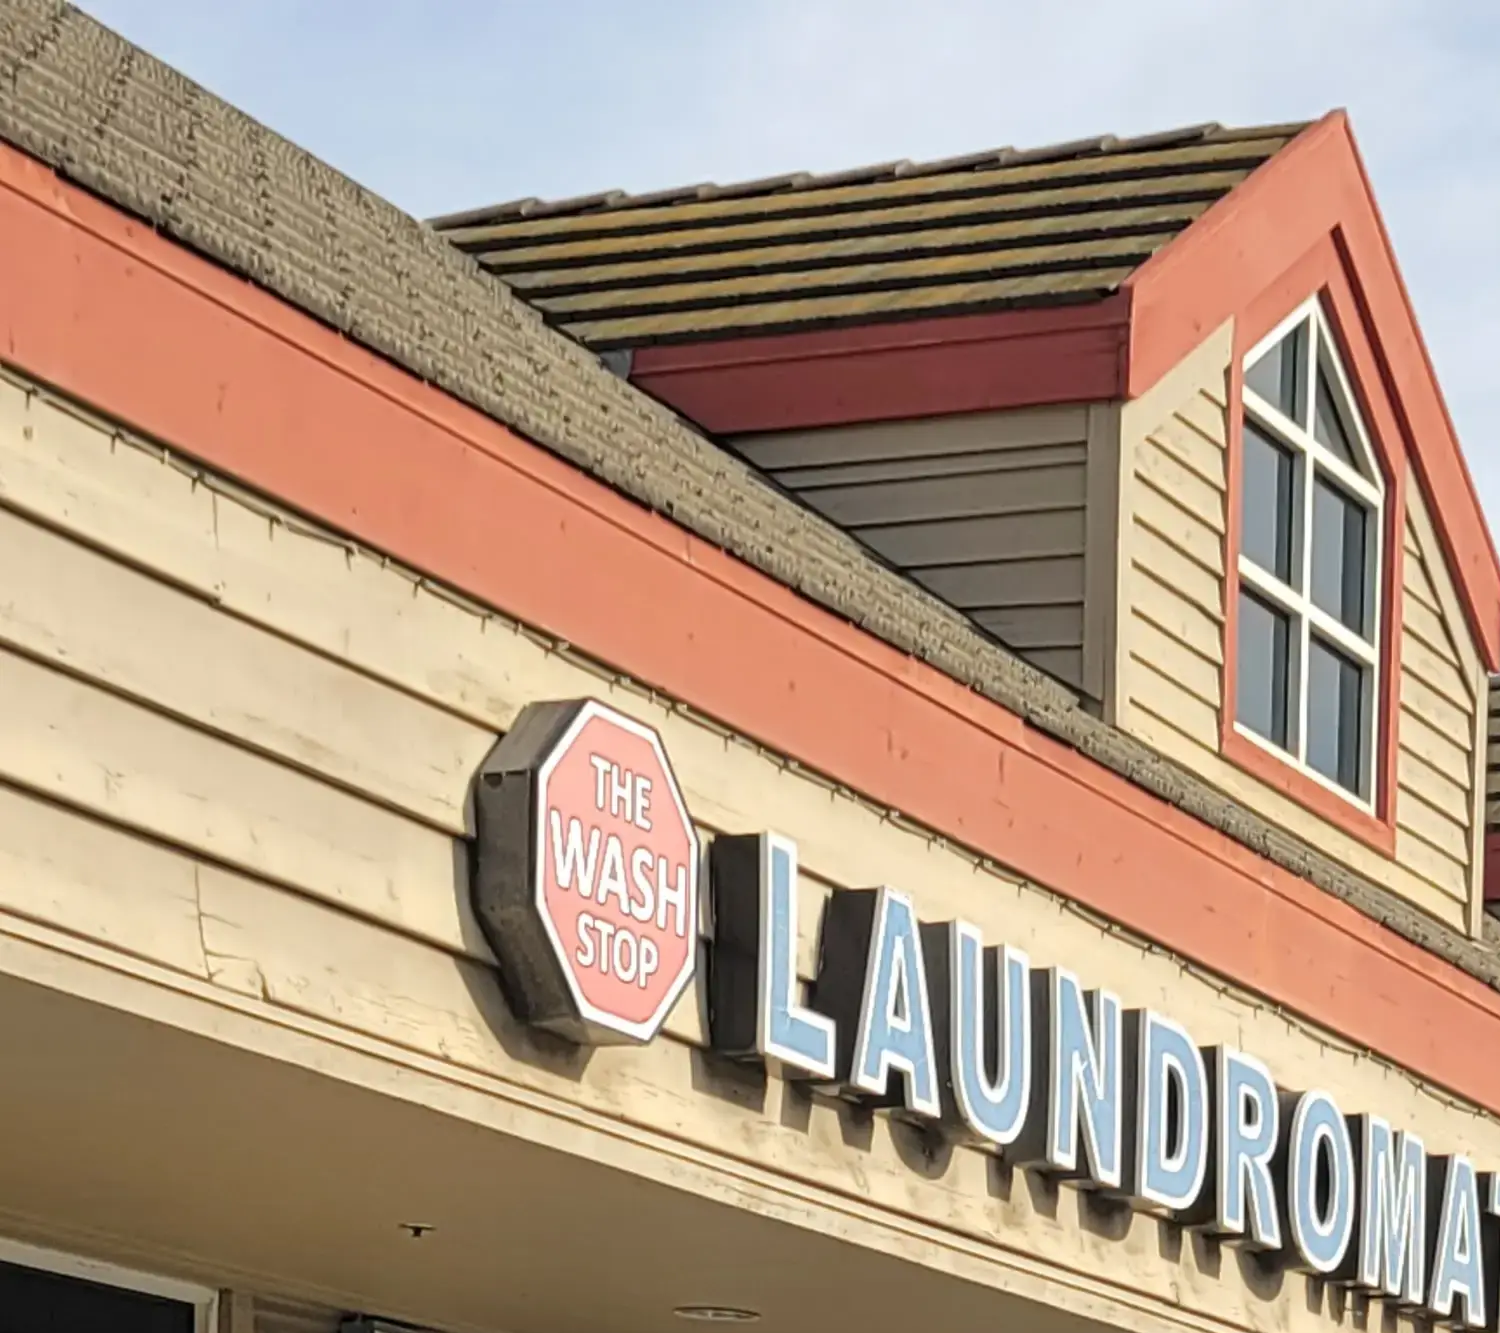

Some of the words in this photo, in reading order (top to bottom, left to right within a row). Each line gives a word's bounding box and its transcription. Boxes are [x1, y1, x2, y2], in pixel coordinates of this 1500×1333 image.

[590, 752, 653, 832] THE
[549, 807, 686, 938] WASH
[576, 911, 658, 990] STOP
